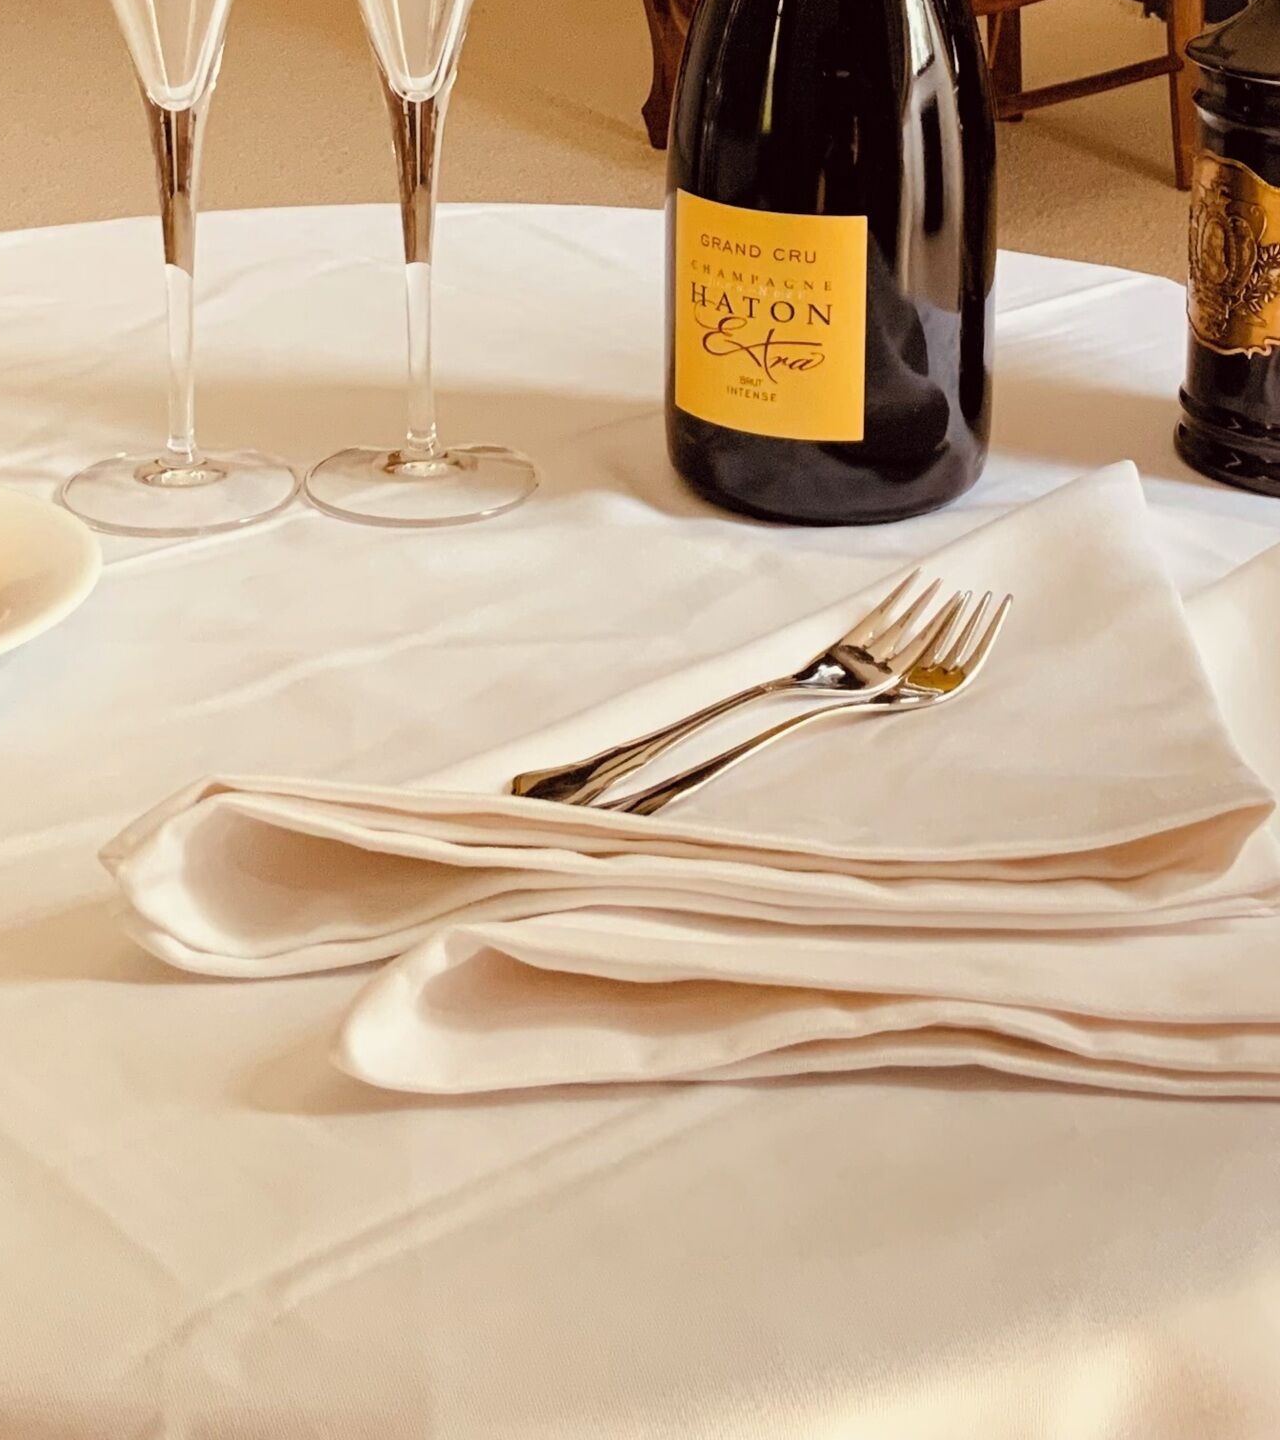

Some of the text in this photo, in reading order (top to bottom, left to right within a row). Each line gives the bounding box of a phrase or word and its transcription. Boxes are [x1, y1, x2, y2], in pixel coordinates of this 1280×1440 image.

[700, 233, 817, 264] GRAND CRU
[690, 259, 833, 292] CHAMPAGNE
[690, 281, 833, 326] HATON
[726, 385, 777, 402] INTENSE
